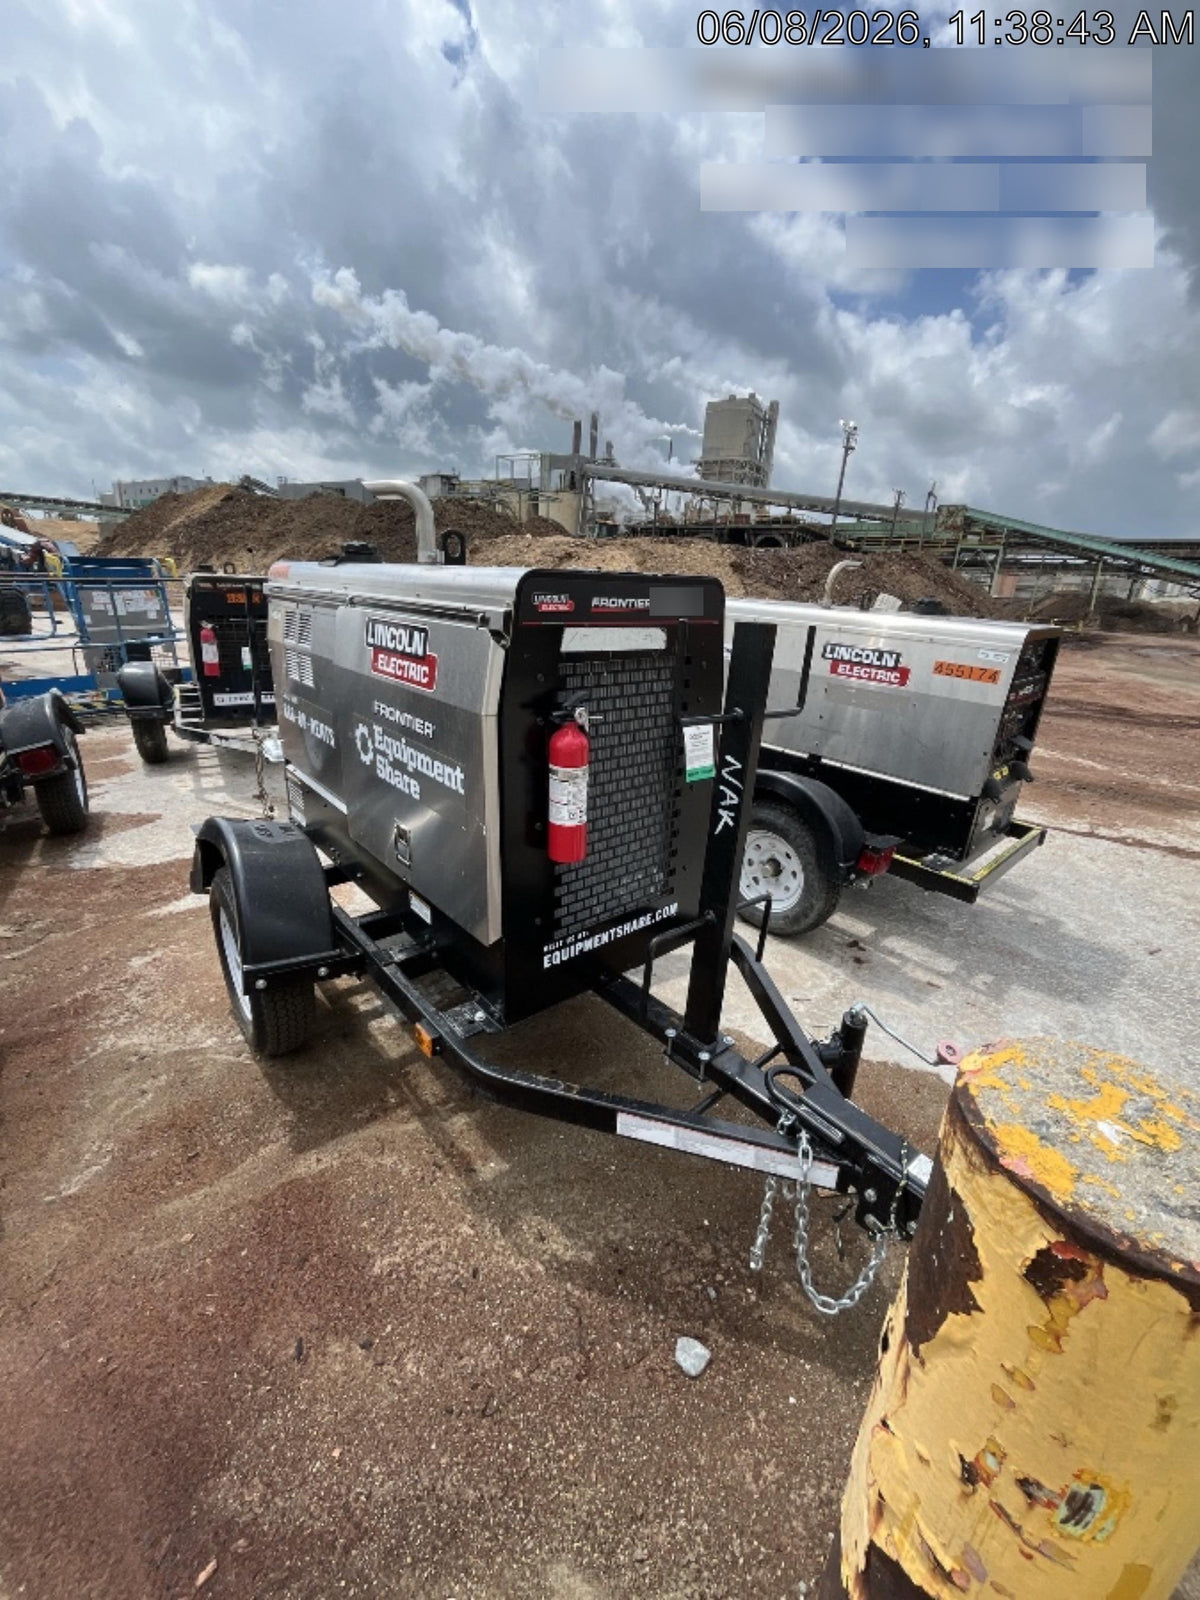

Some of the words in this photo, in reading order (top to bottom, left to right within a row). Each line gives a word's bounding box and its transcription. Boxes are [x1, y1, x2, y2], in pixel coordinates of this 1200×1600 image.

[367, 621, 425, 657] LINCOLN
[825, 644, 897, 667] LINCOLN
[378, 653, 430, 684] ELECTRIC
[837, 664, 901, 683] ELECTRIC
[933, 661, 1000, 684] 455174
[374, 700, 433, 739] FRONTIER
[373, 723, 465, 795] Equipment
[376, 754, 421, 800] Share
[543, 902, 679, 970] EQUIPMENTSHARE.COM
